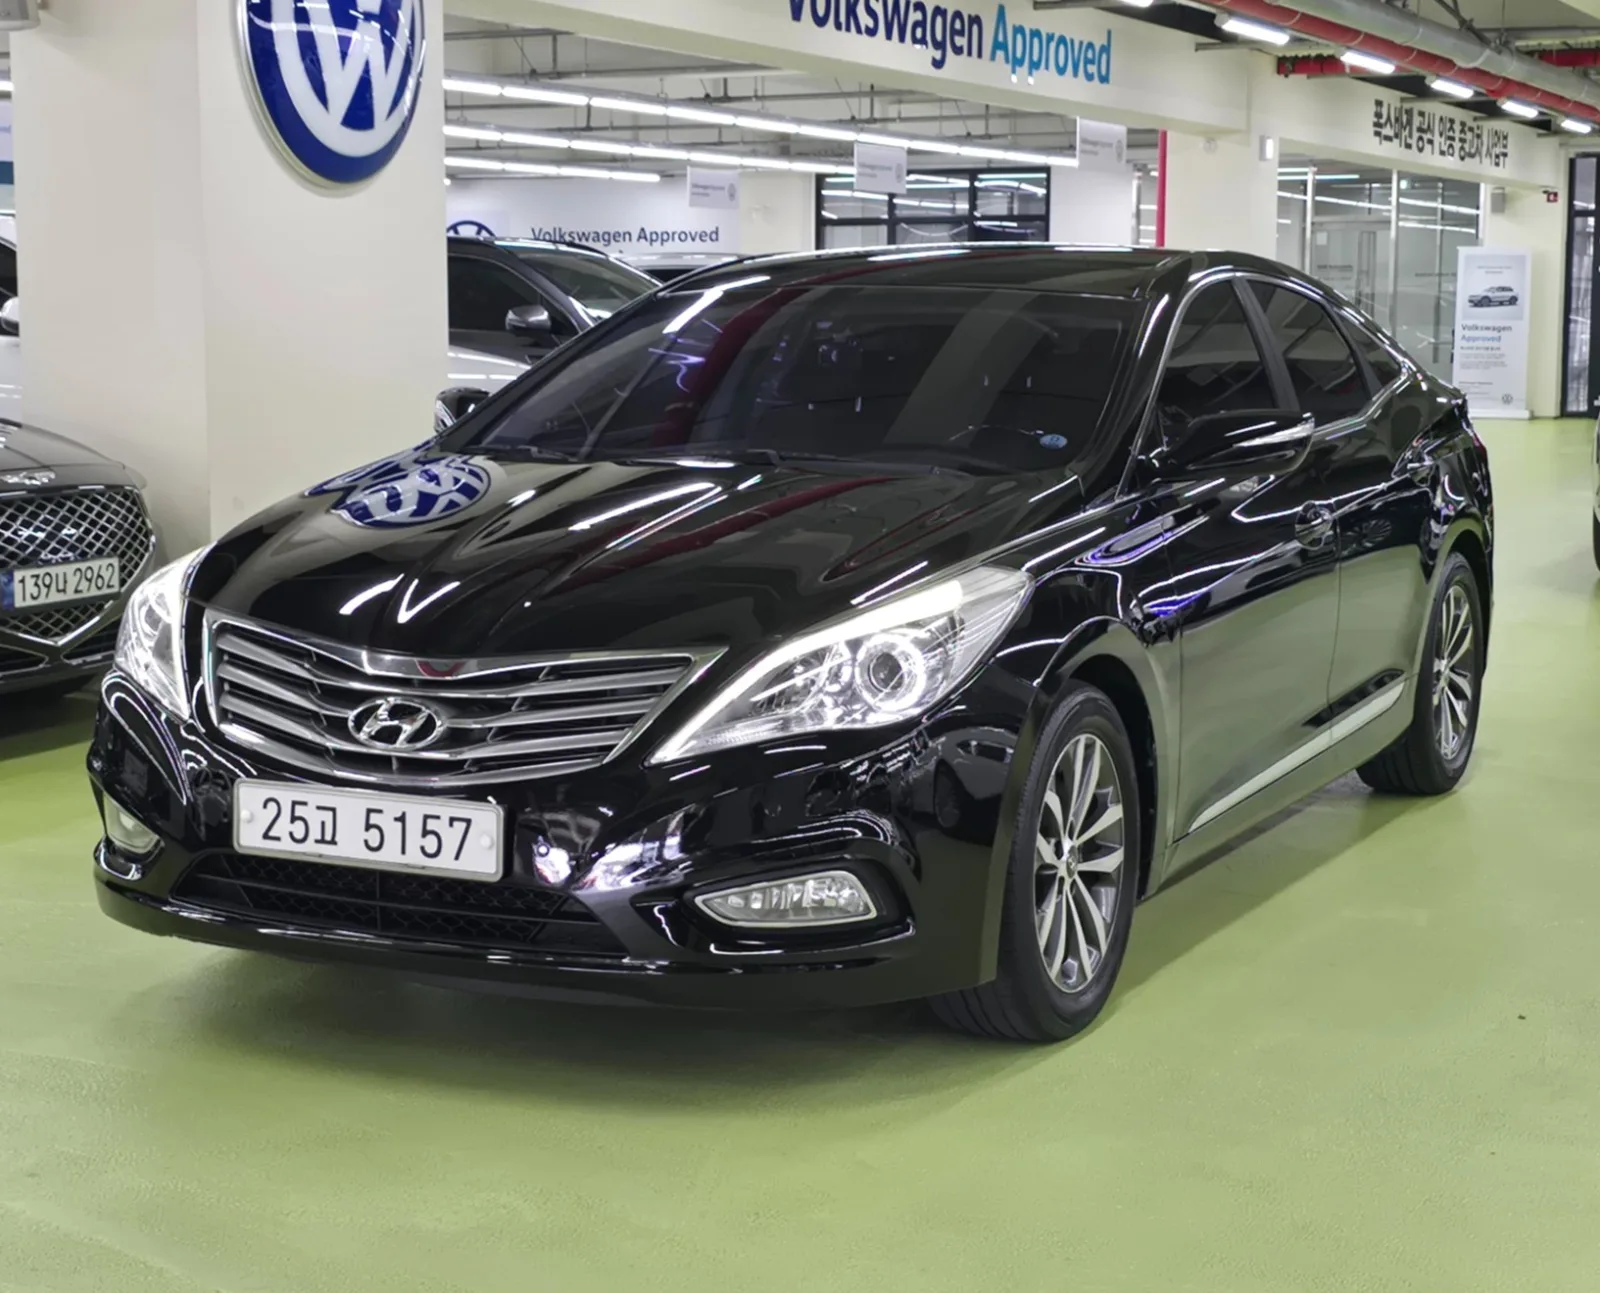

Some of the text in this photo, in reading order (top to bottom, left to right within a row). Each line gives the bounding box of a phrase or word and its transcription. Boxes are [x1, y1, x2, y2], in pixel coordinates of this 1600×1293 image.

[990, 3, 1112, 85] Approved
[1372, 98, 1508, 168] 폭스바겐 공식 인증 중고차 사업부
[531, 226, 720, 246] Volkswagen Approved
[1461, 323, 1512, 333] Volkswagen
[18, 563, 115, 602] 139나 2962
[262, 797, 473, 861] 25고 5157
